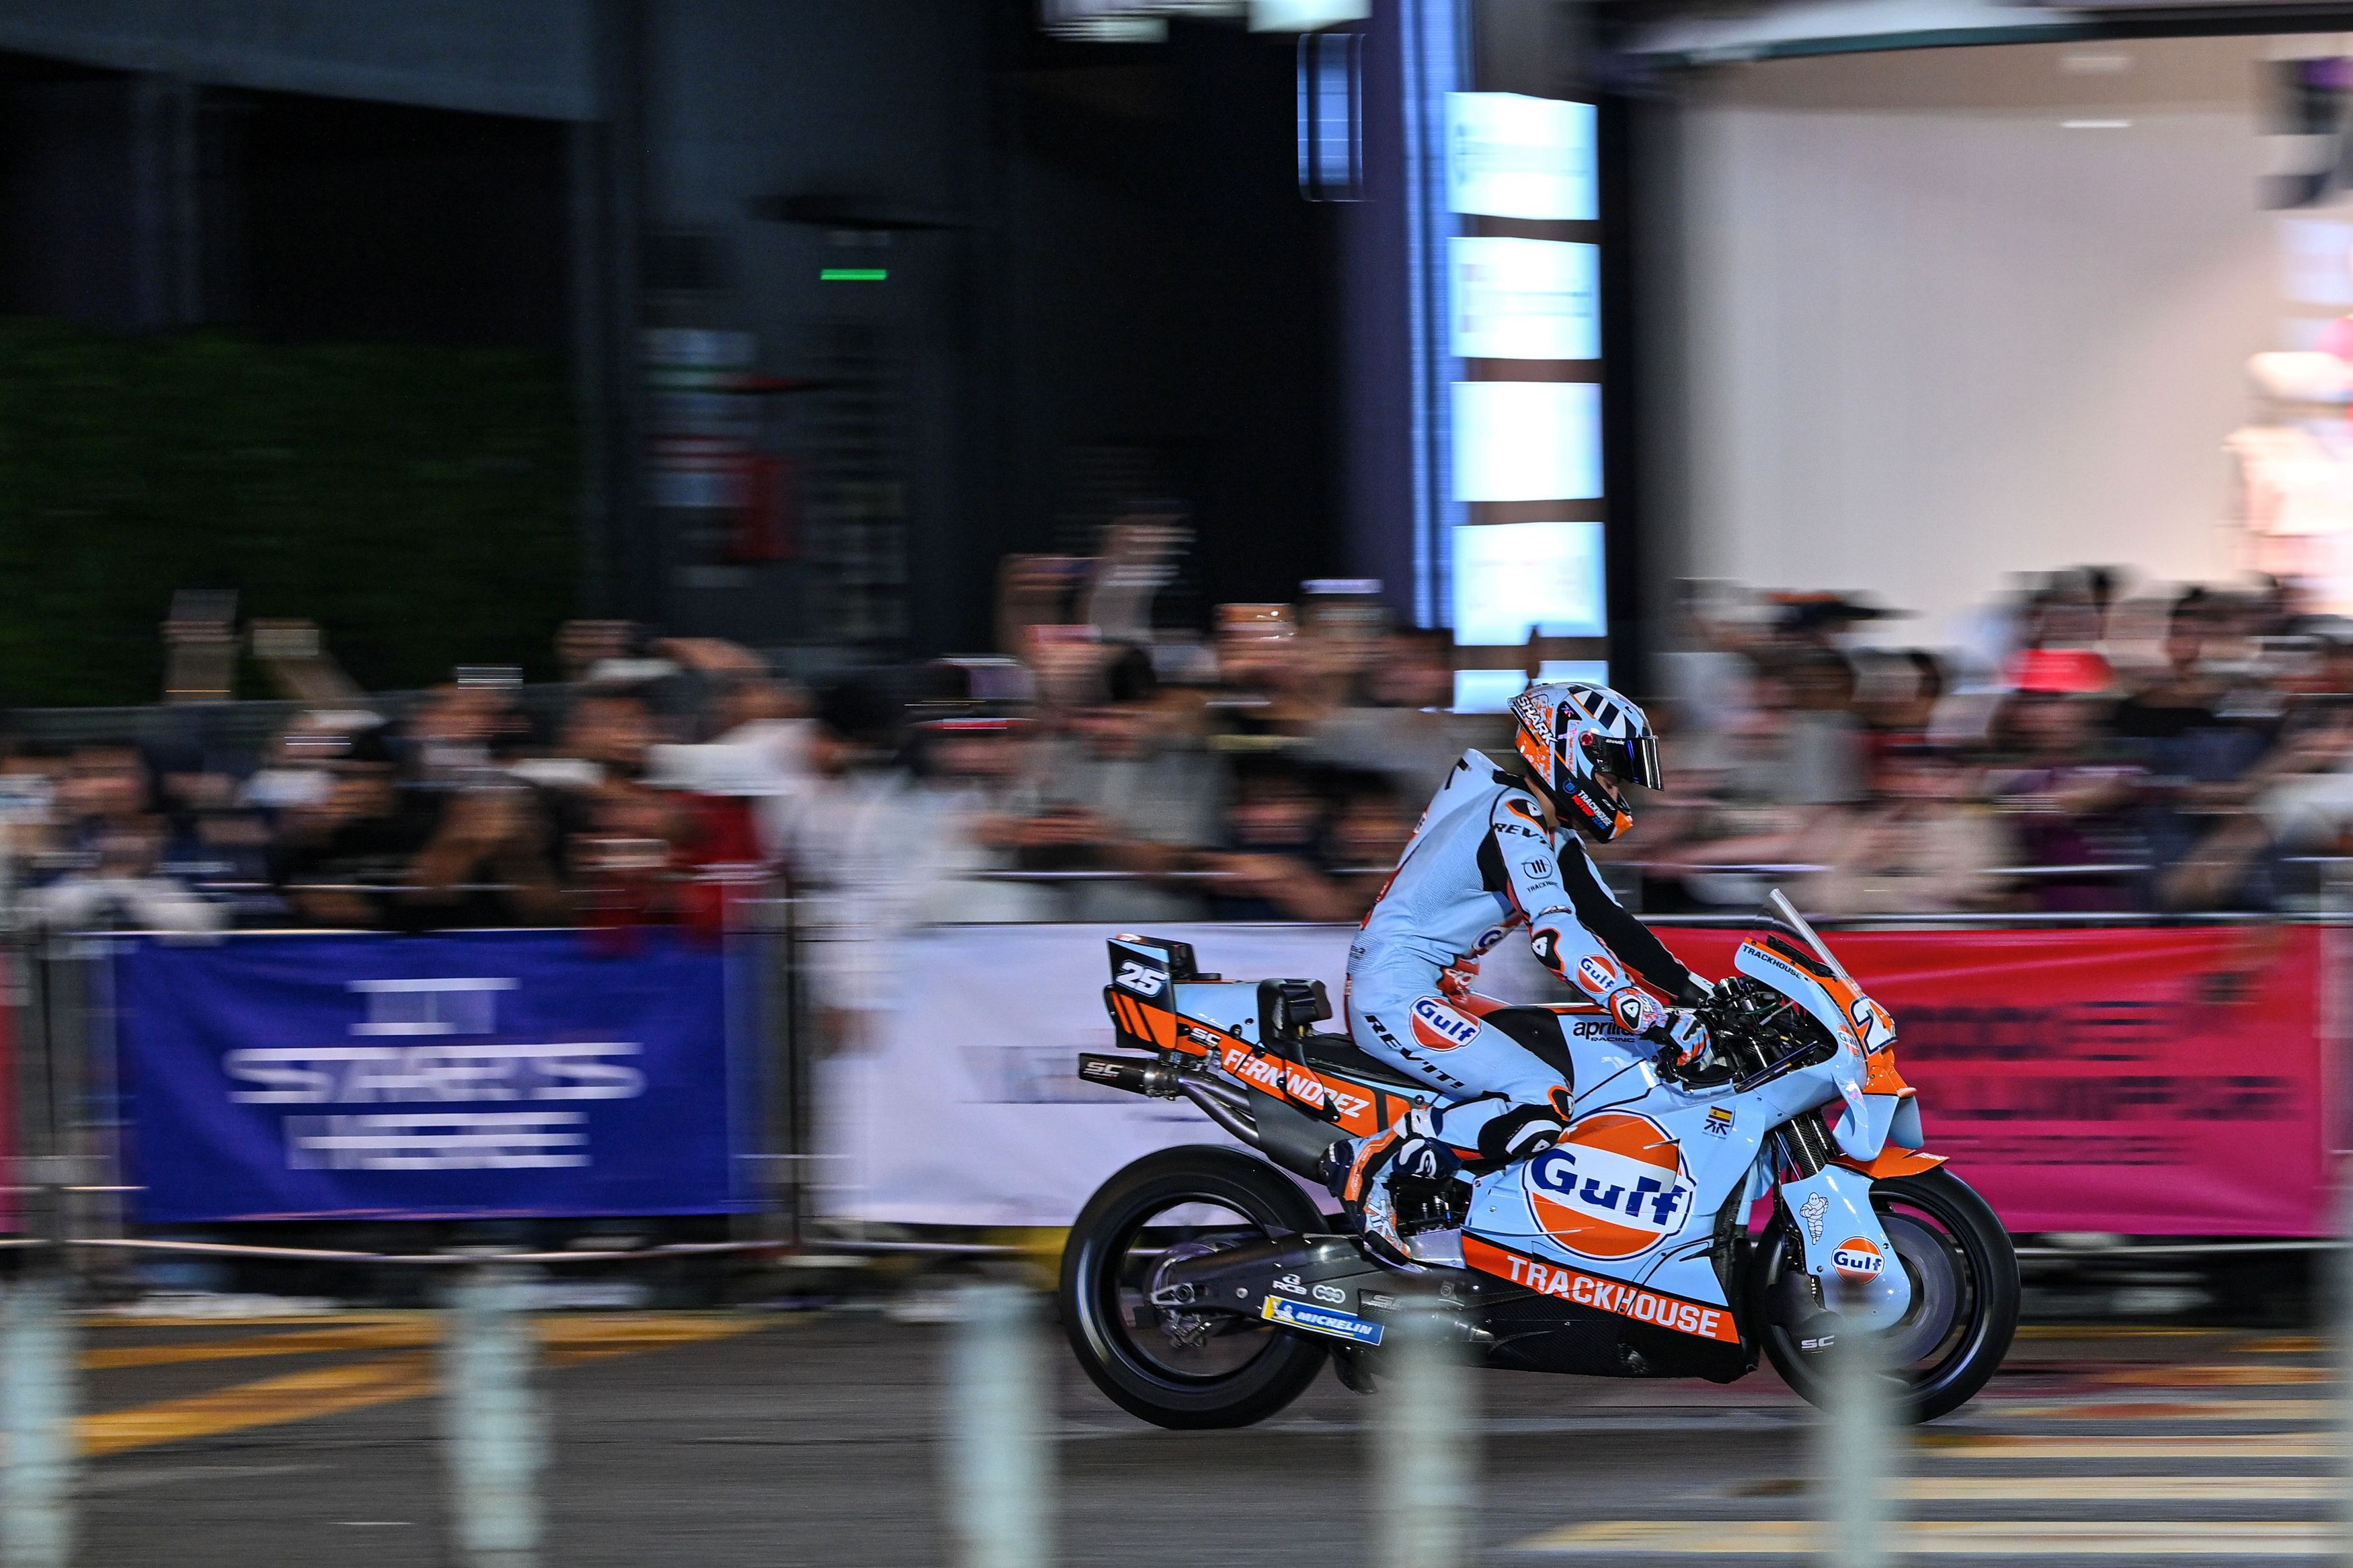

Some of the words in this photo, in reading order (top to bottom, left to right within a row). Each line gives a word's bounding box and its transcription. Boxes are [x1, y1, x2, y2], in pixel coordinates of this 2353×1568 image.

[1517, 696, 1558, 747] SHARK
[1581, 958, 1615, 989] Gulf
[1743, 945, 1802, 980] TRACKHOUSE
[1115, 960, 1170, 997] 25
[1416, 999, 1476, 1042] Gulf
[1190, 1027, 1222, 1046] SC
[1085, 1061, 1124, 1075] SC
[1531, 1149, 1685, 1226] Gulf
[1833, 1251, 1882, 1272] Gulf
[1272, 1280, 1308, 1295] RCB
[1507, 1255, 1721, 1338] TRACKHOUSE
[1295, 1311, 1373, 1335] MICHELIN
[1801, 1335, 1835, 1349] SC
